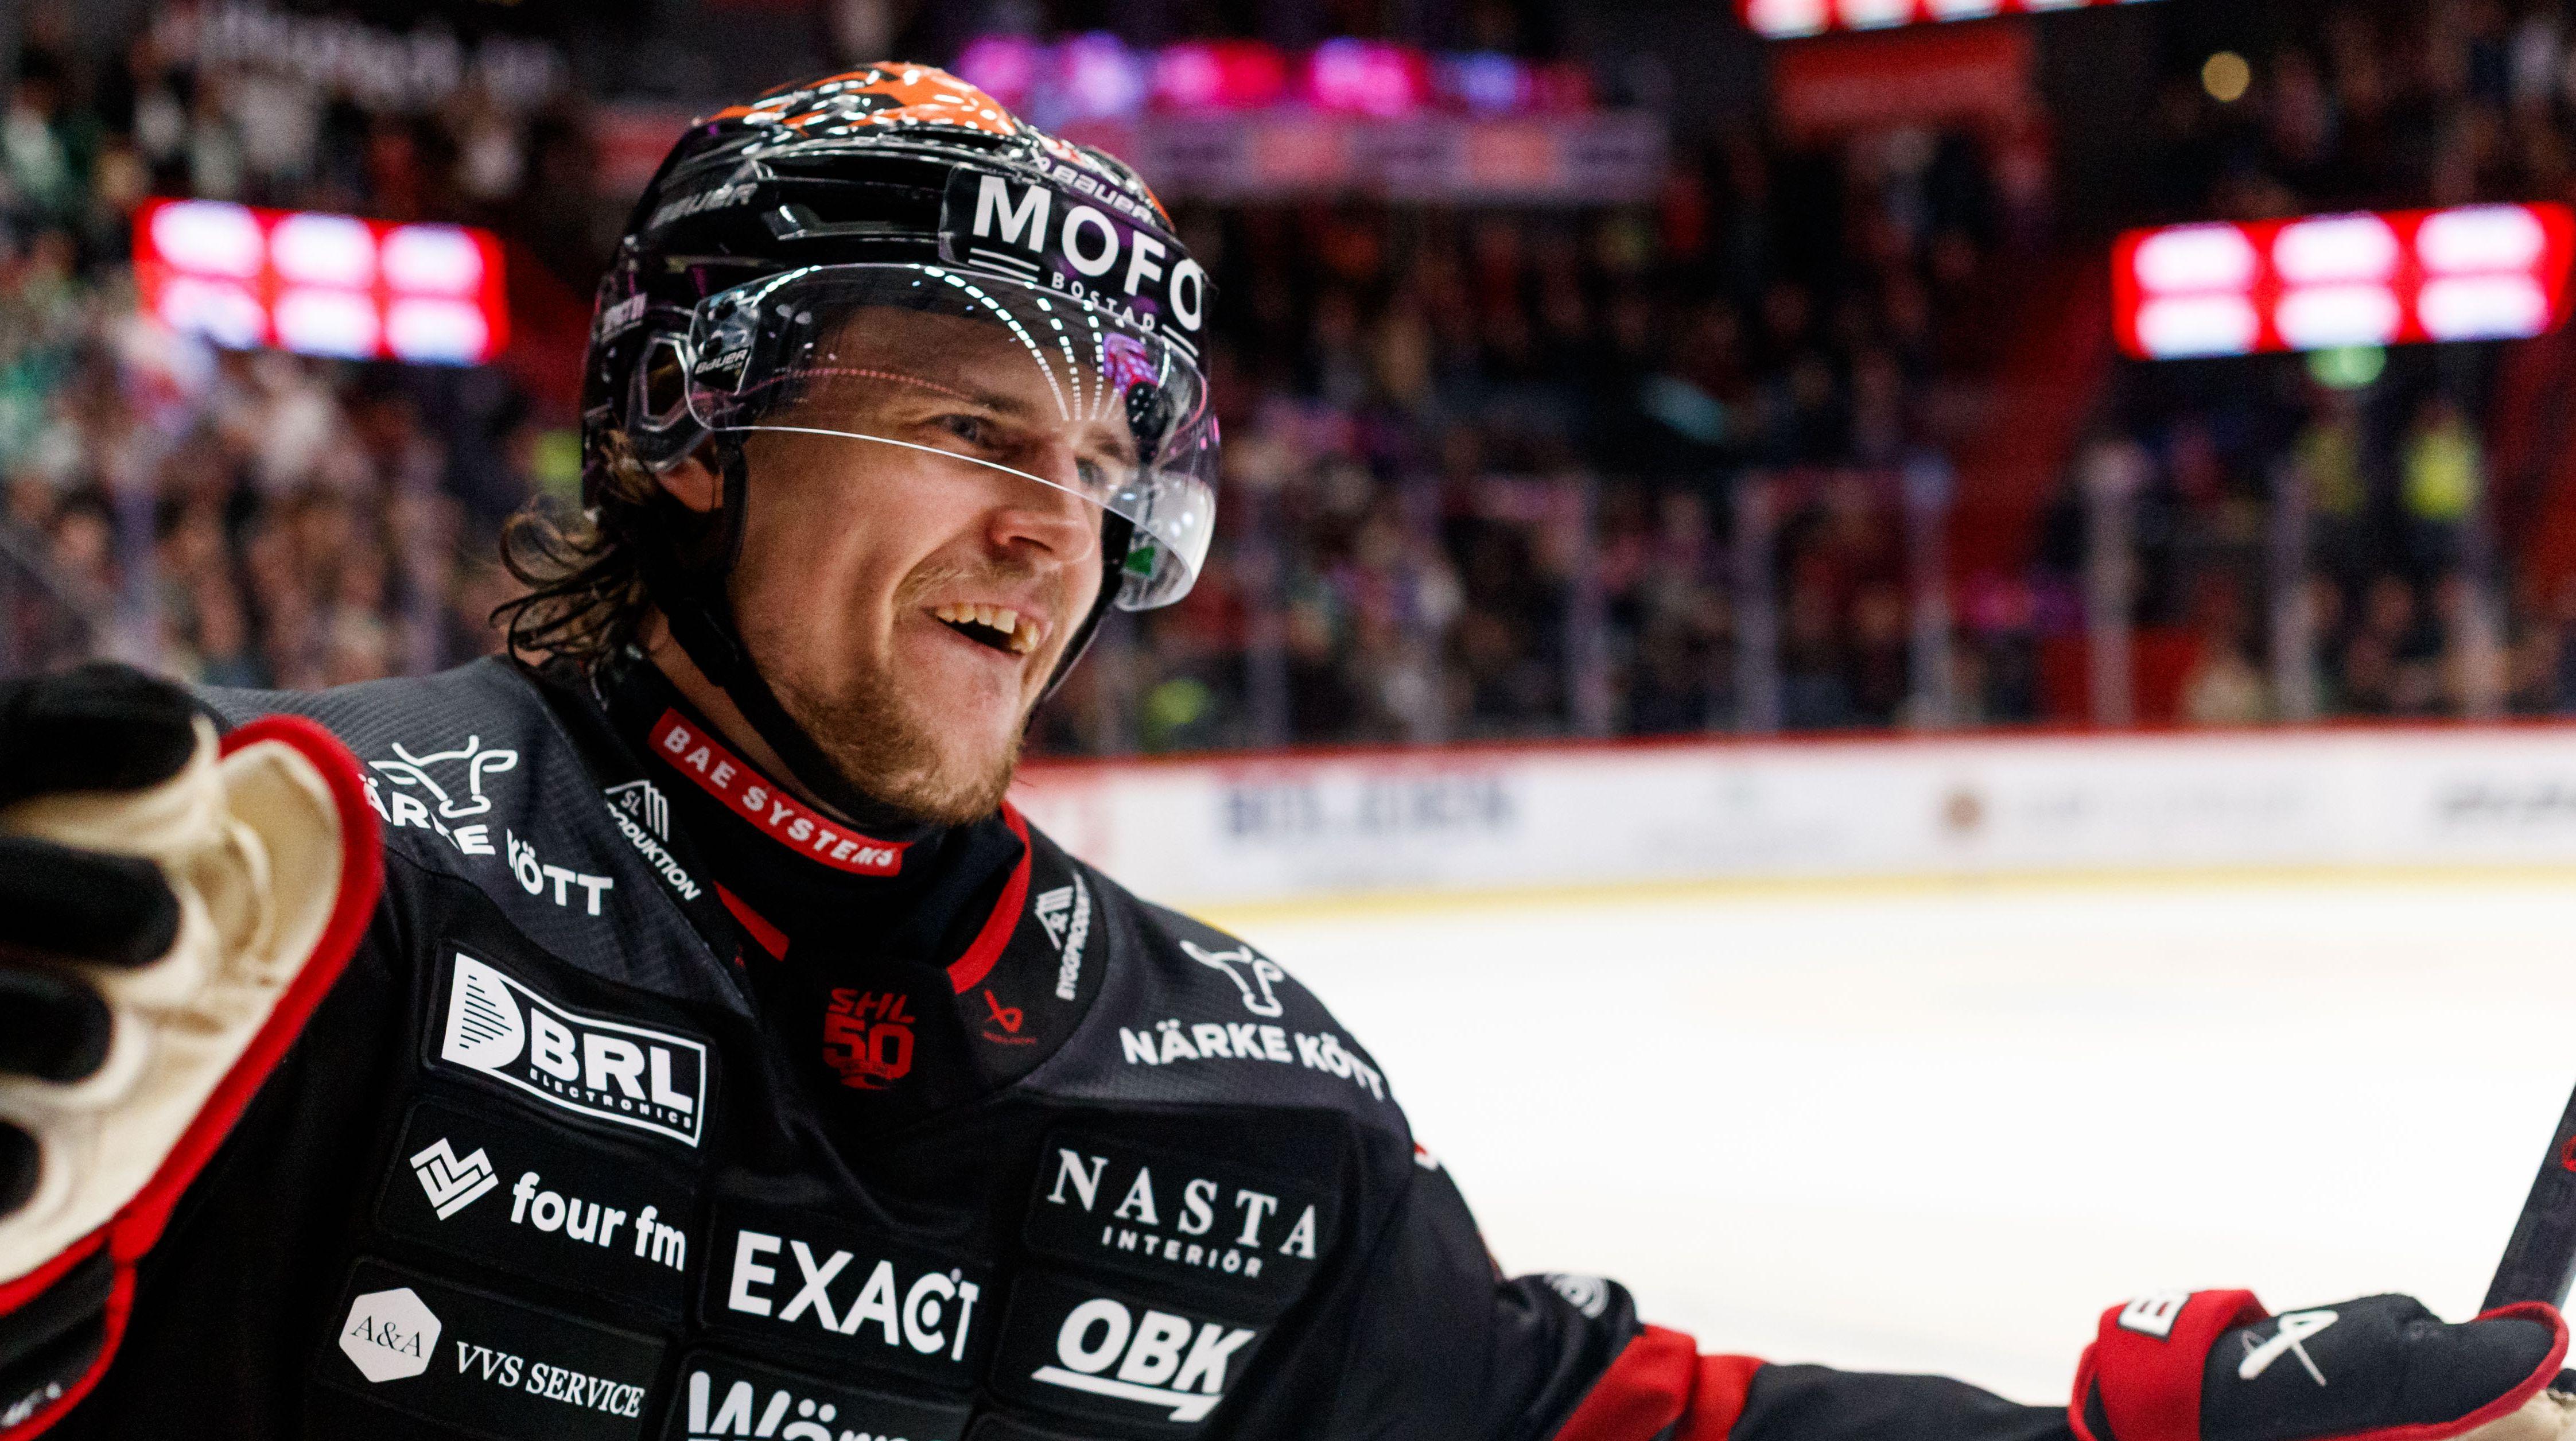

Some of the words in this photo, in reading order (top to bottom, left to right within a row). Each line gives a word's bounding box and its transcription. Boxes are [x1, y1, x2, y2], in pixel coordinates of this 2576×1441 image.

[973, 174, 1203, 332] MOFO
[1051, 271, 1156, 332] BOSTAD
[663, 725, 737, 789] BAE
[507, 828, 613, 916] KÖTT
[827, 988, 916, 1024] SHL
[822, 1012, 915, 1080] 50
[1119, 1019, 1293, 1065] NÄRKE
[1295, 1032, 1385, 1101] KÖTT
[530, 1067, 693, 1129] ELECTRONICS
[510, 1171, 627, 1248] four
[635, 1205, 686, 1272] fm
[1047, 1148, 1316, 1259] NASTA
[728, 1230, 980, 1361] EXACT
[350, 1314, 423, 1359] A&A
[1057, 1298, 1256, 1395] OBK
[456, 1341, 524, 1388] VVS
[526, 1362, 646, 1418] SERVICE
